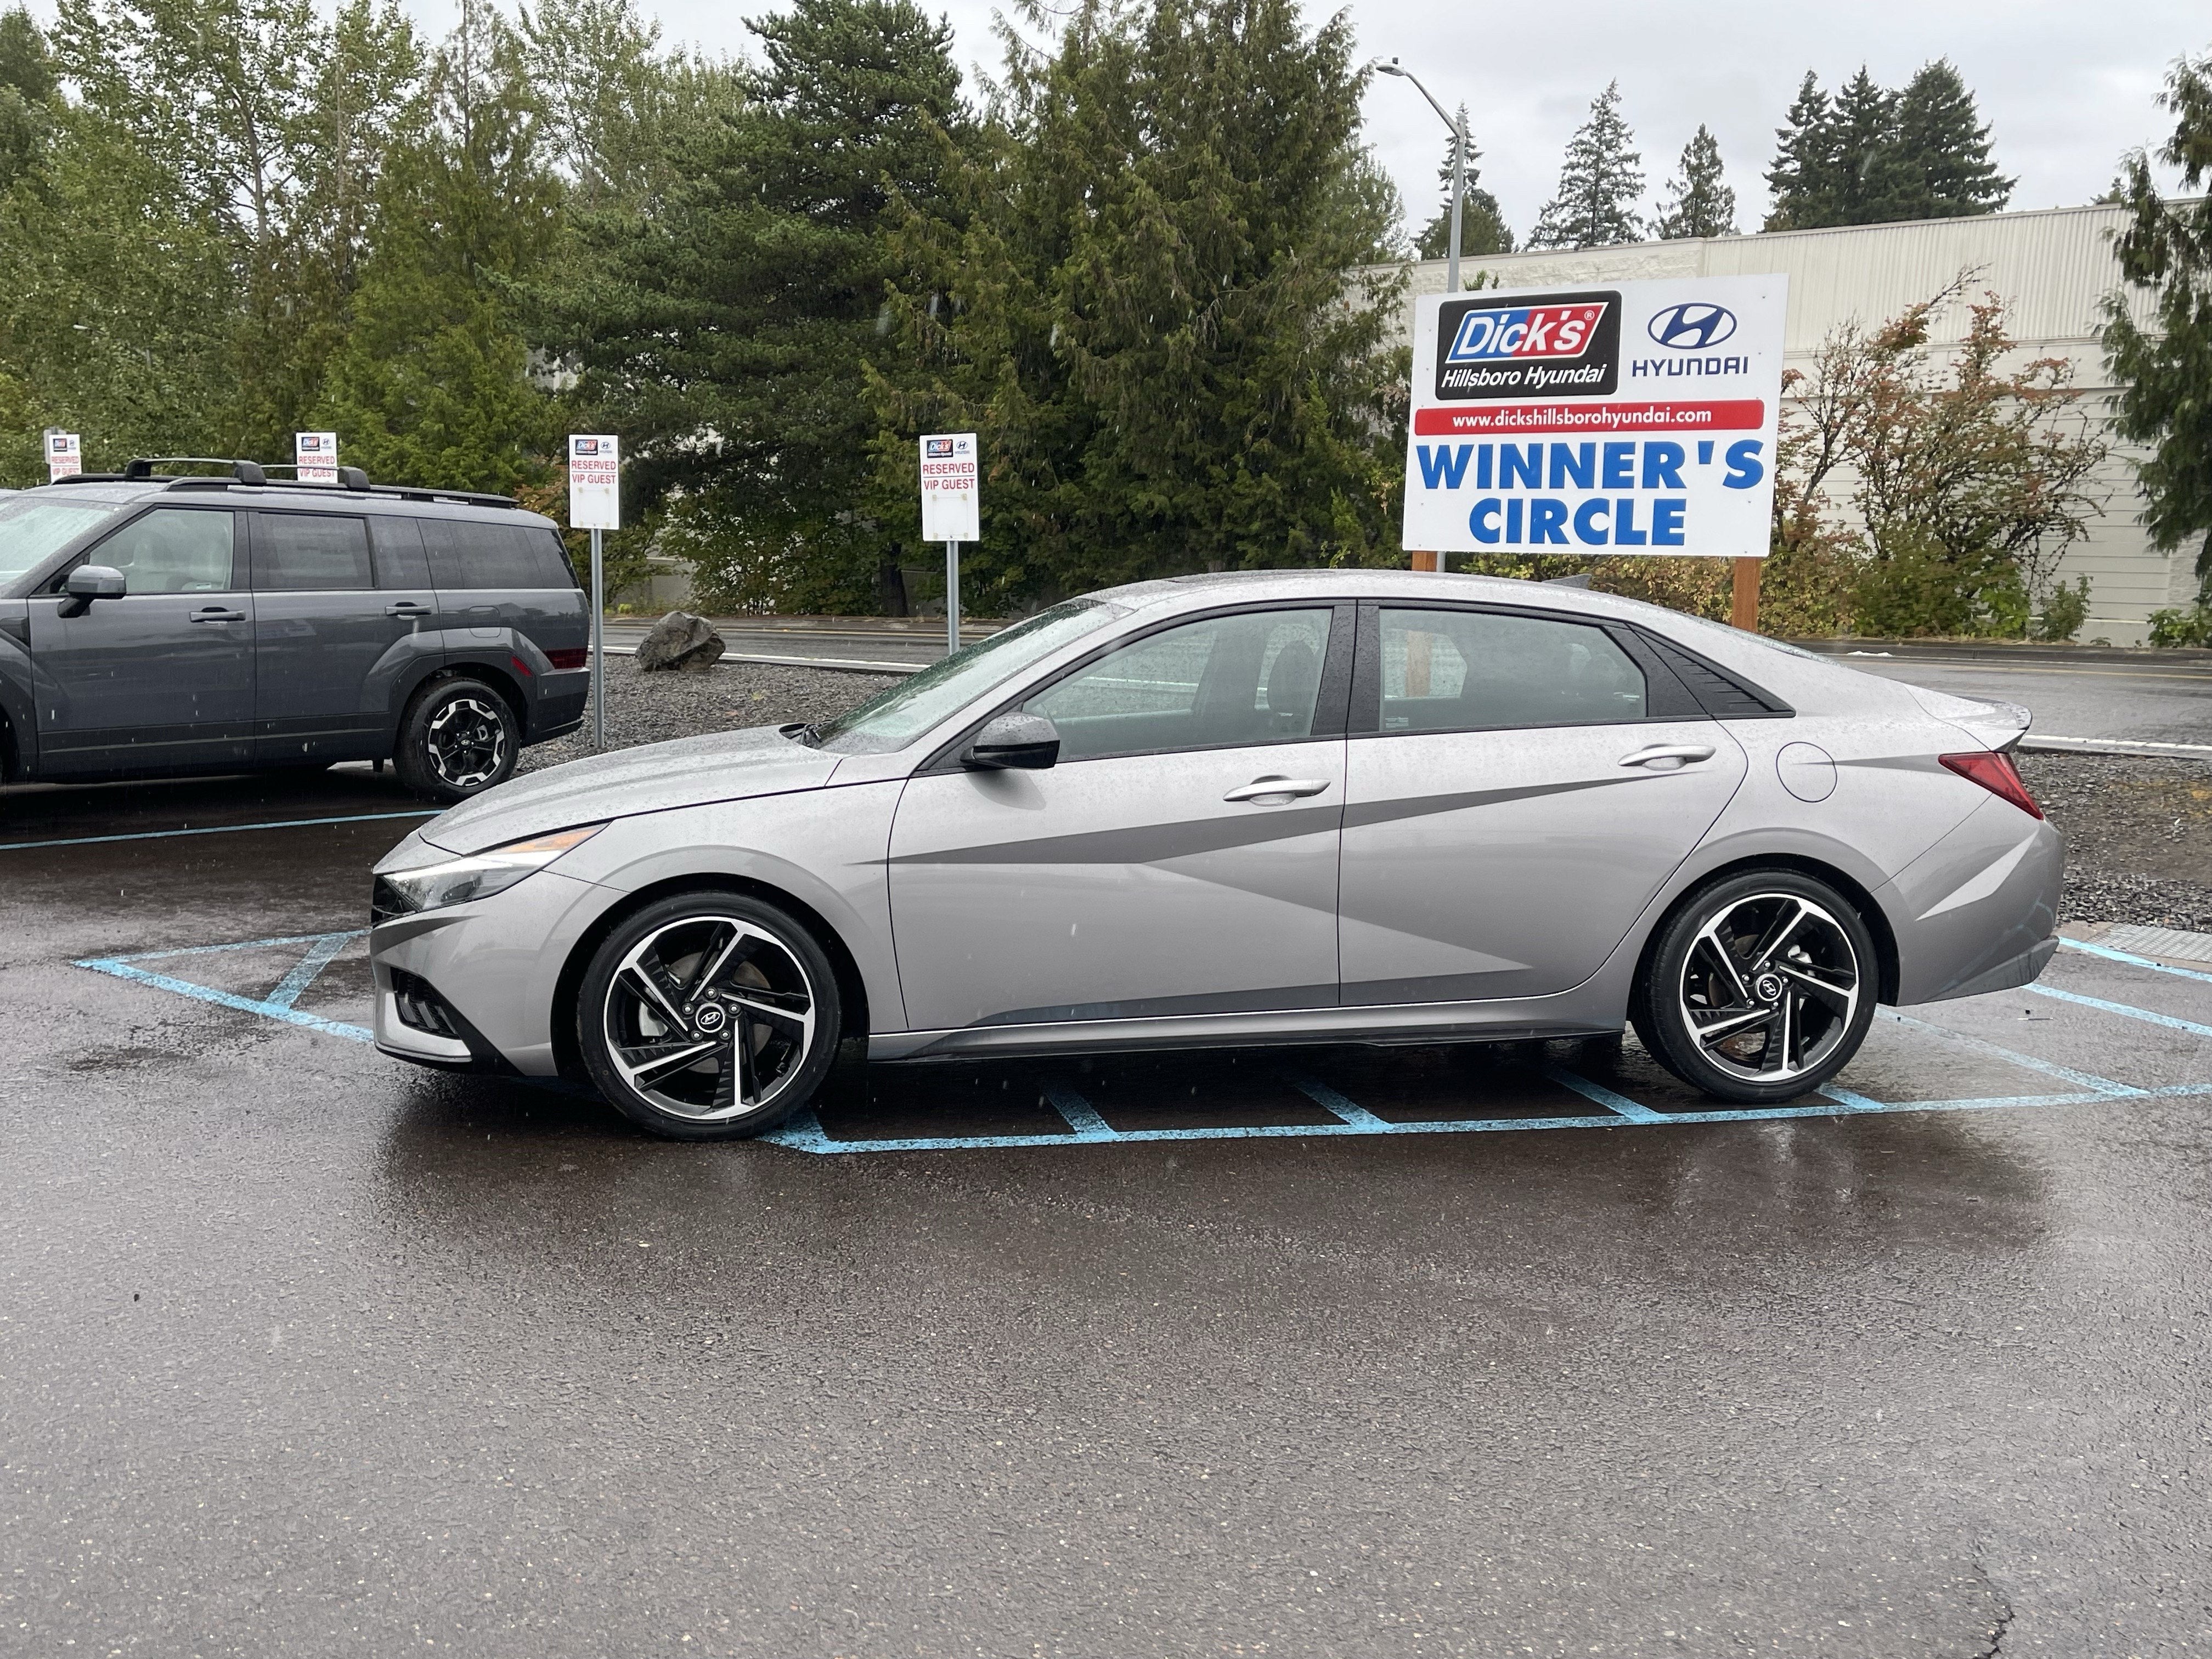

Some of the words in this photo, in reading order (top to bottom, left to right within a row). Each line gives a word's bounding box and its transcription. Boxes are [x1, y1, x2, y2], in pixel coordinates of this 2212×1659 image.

[1632, 356, 1748, 377] HYUNDAI
[1441, 368, 1521, 388] Hillsboro
[1524, 364, 1607, 389] Hyundai
[1453, 407, 1712, 429] www.dickshillsborohyundai.com
[298, 456, 335, 464] RESERVED
[571, 460, 616, 470] RESERVED
[1417, 439, 1763, 489] WINNER'S
[300, 468, 310, 477] VIP
[923, 462, 975, 475] RESERVED
[572, 473, 585, 483] VIP
[588, 474, 616, 484] GUEST
[924, 479, 939, 490] VIP
[941, 478, 975, 490] GUEST
[1469, 498, 1686, 546] CIRCLE
